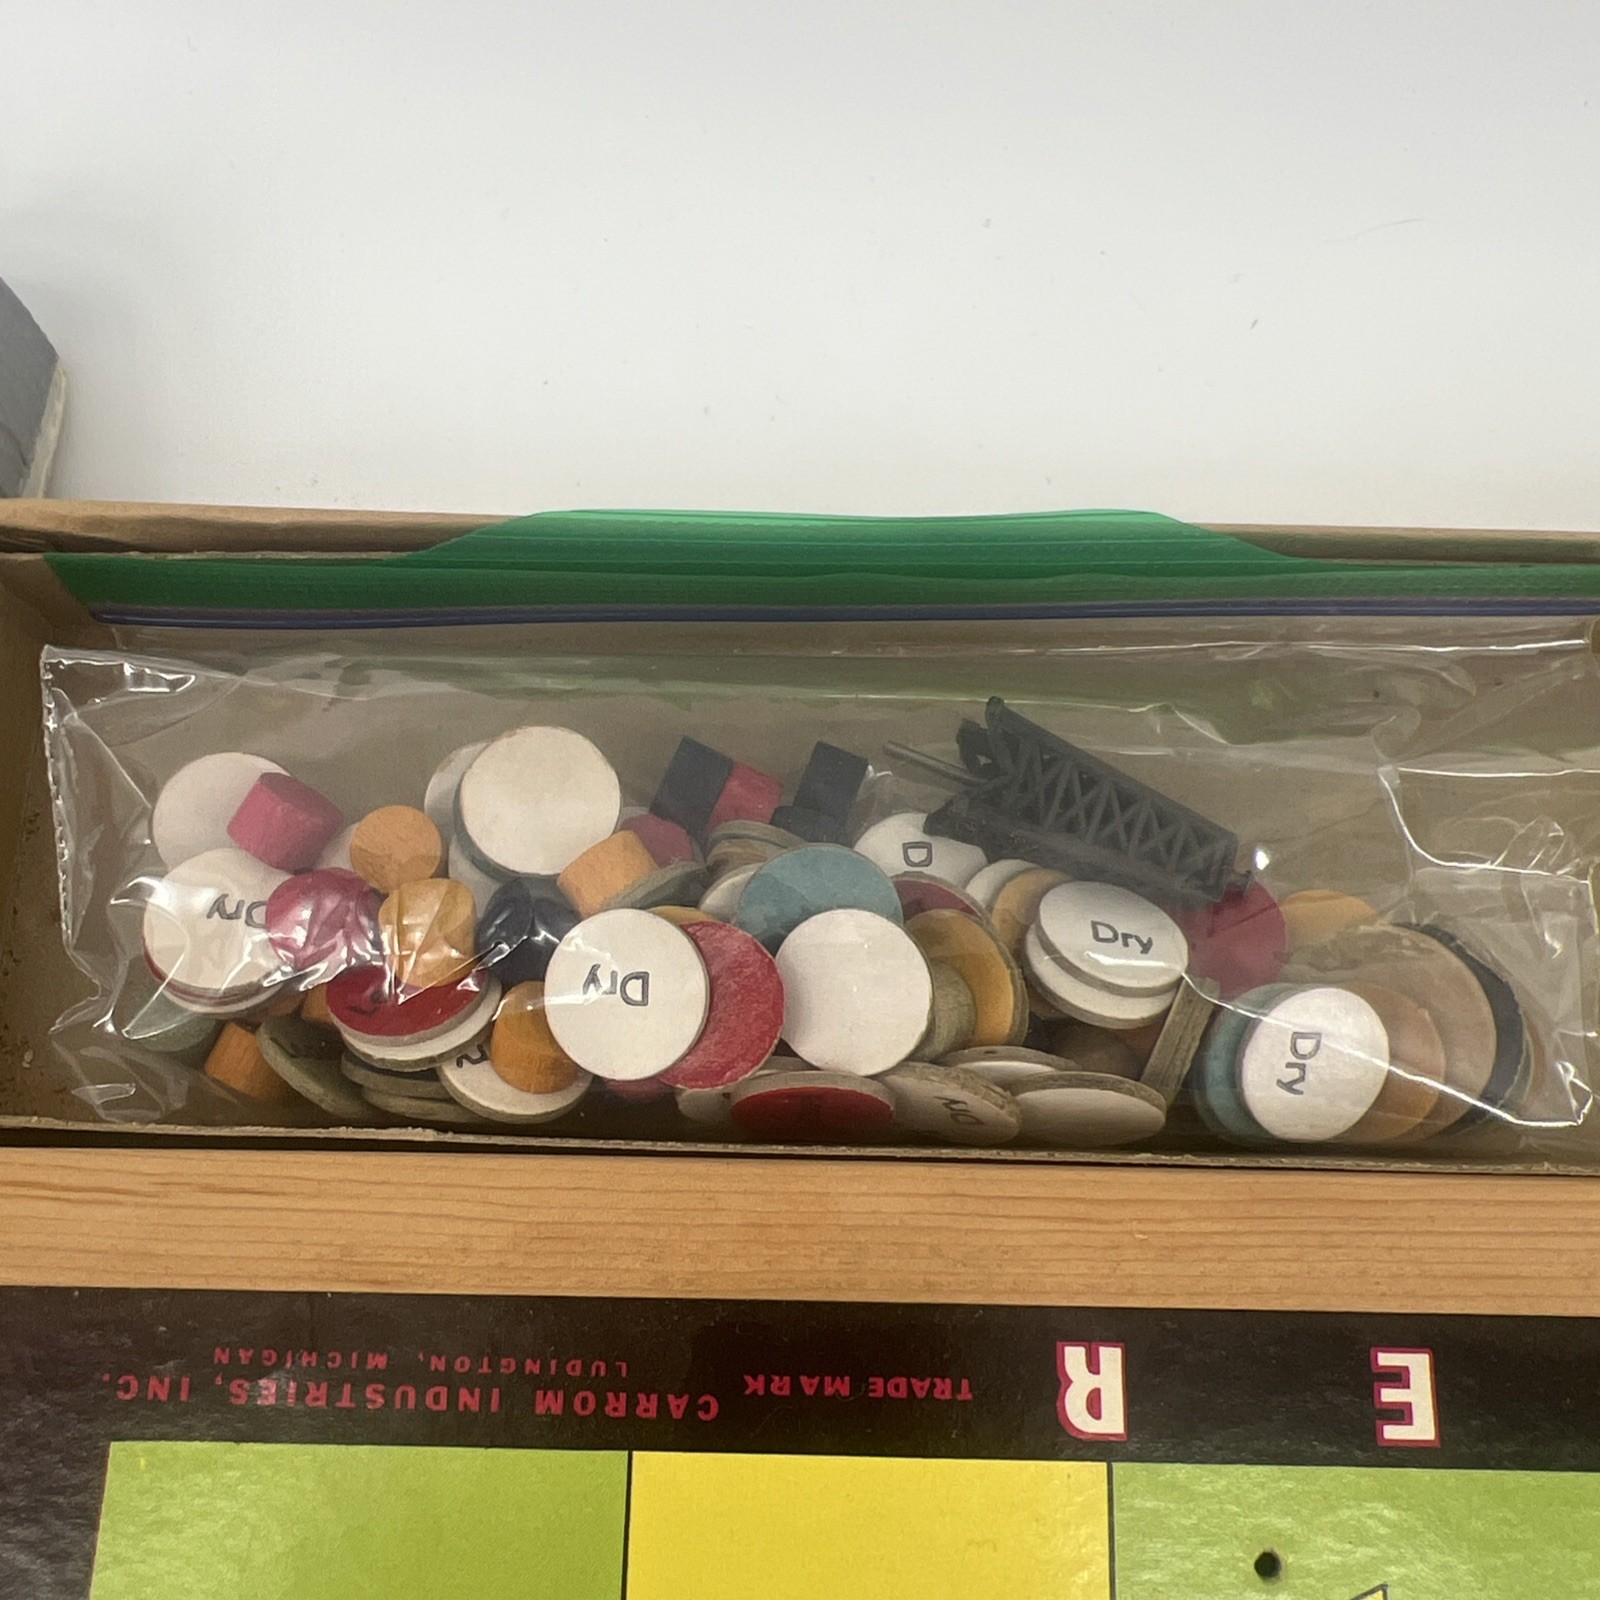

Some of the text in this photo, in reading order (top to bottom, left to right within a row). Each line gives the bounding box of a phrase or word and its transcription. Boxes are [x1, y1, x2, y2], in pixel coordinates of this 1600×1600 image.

[1090, 920, 1154, 955] Dry
[582, 963, 650, 1007] Dry
[1275, 1031, 1323, 1095] Dry
[213, 1347, 629, 1378] LUDINGTON, MICHIGAN
[101, 1372, 720, 1422] CARROM INDUSTRIES, INC.
[743, 1373, 974, 1401] TRADE MARK
